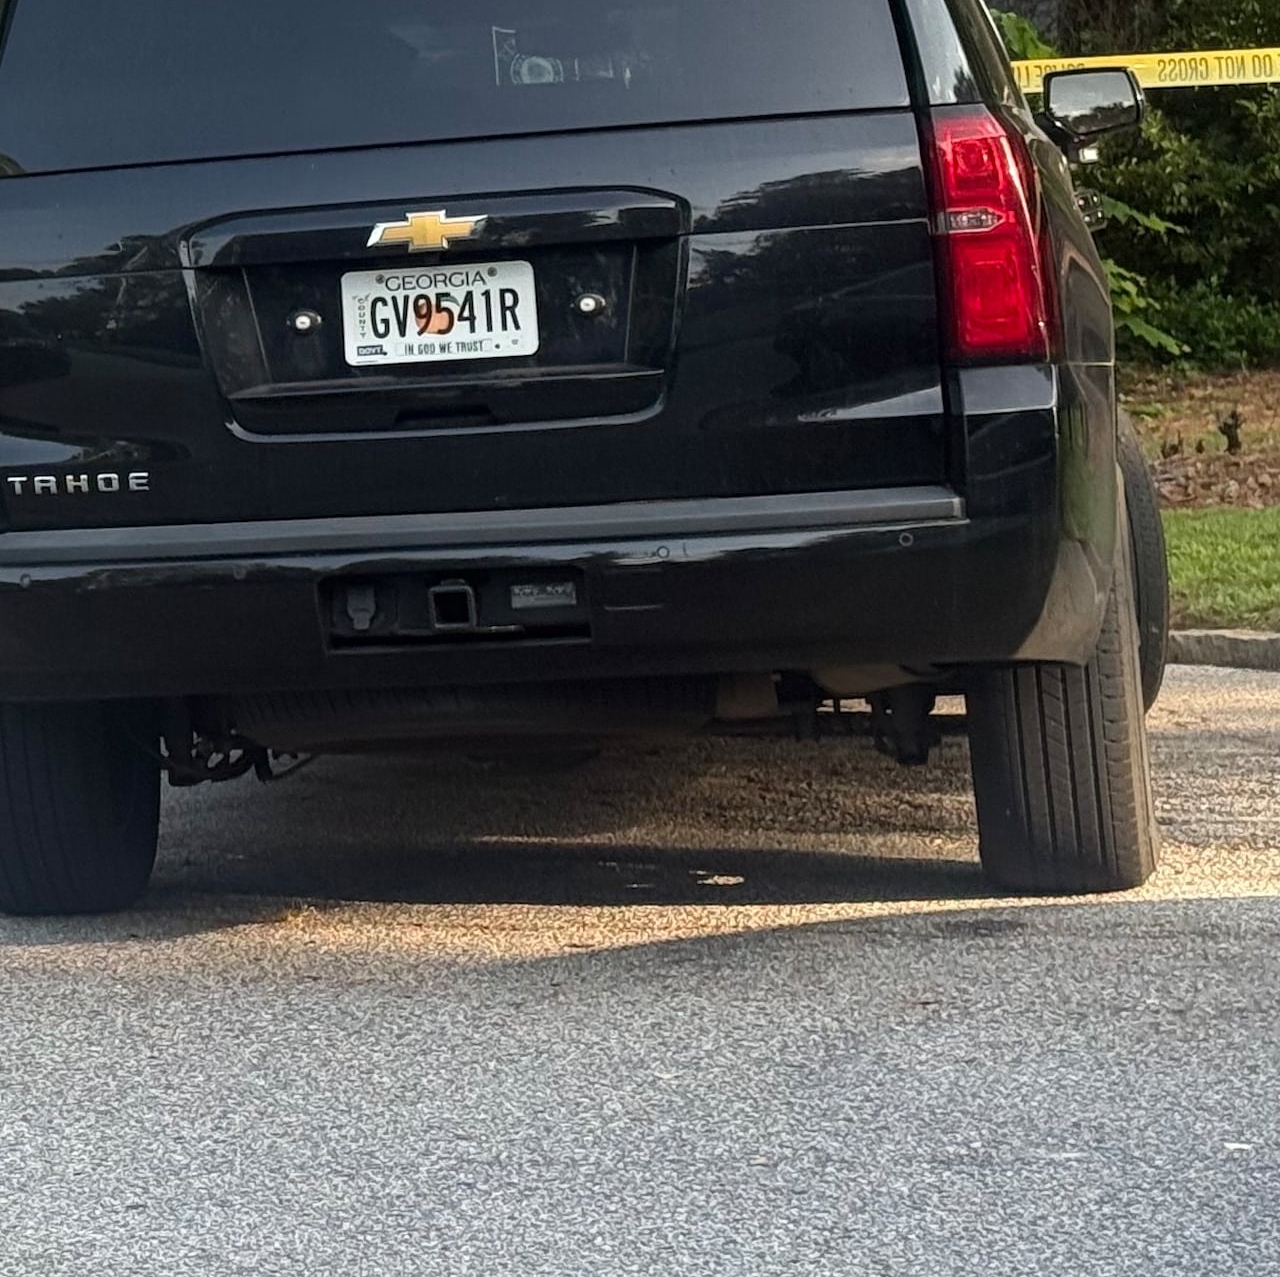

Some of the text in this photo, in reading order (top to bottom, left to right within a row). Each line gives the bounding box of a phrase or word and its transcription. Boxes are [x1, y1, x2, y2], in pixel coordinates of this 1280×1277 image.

[385, 271, 486, 291] GEORGIA
[370, 288, 521, 339] GV9541R
[405, 341, 483, 355] IN GOD WE TRUST
[7, 472, 150, 495] TAHOE
